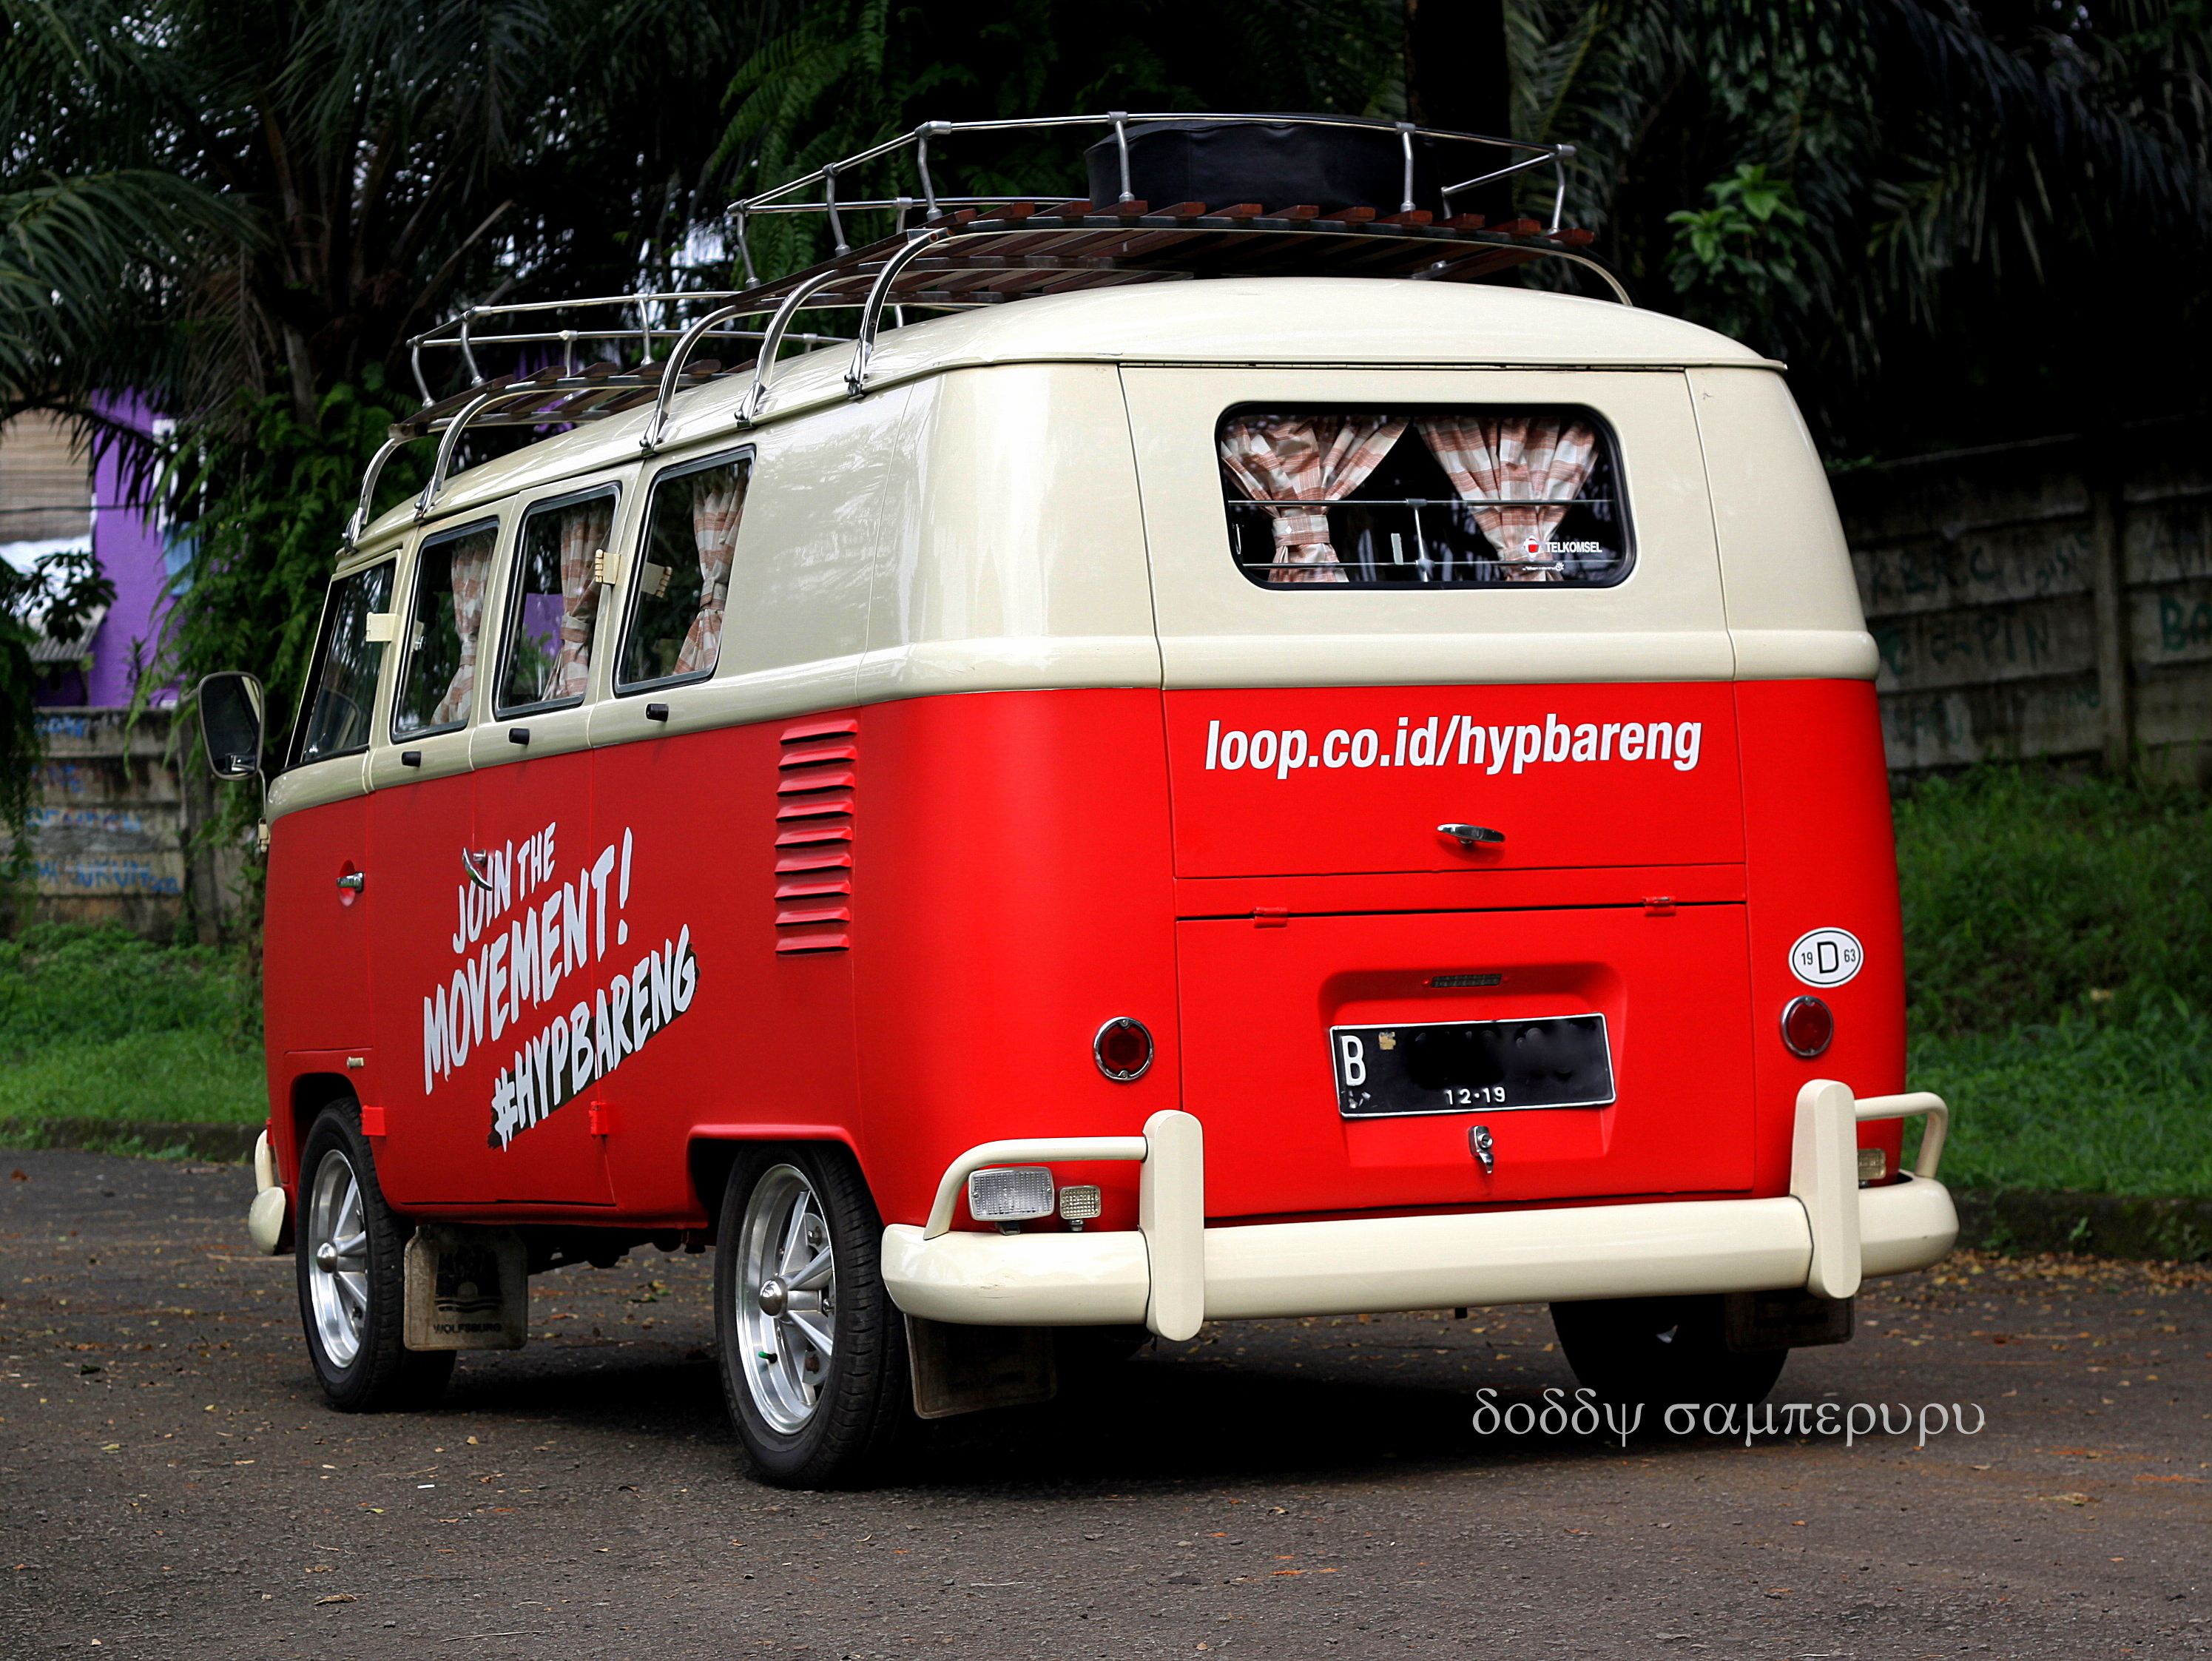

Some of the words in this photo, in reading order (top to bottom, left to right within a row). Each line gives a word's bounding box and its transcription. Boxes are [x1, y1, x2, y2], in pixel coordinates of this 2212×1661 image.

[1545, 542, 1602, 553] TELKOMSEL
[1205, 713, 1702, 780] loop.co.id/hypbareng
[452, 839, 513, 954] JOIN
[517, 821, 556, 902] THE
[423, 826, 633, 1096] MOVEMENT!
[1801, 951, 1813, 966] 19
[1817, 940, 1839, 974] D
[1844, 949, 1856, 963] 63
[490, 923, 696, 1153] #HYPBARENG
[1341, 1035, 1366, 1087] B
